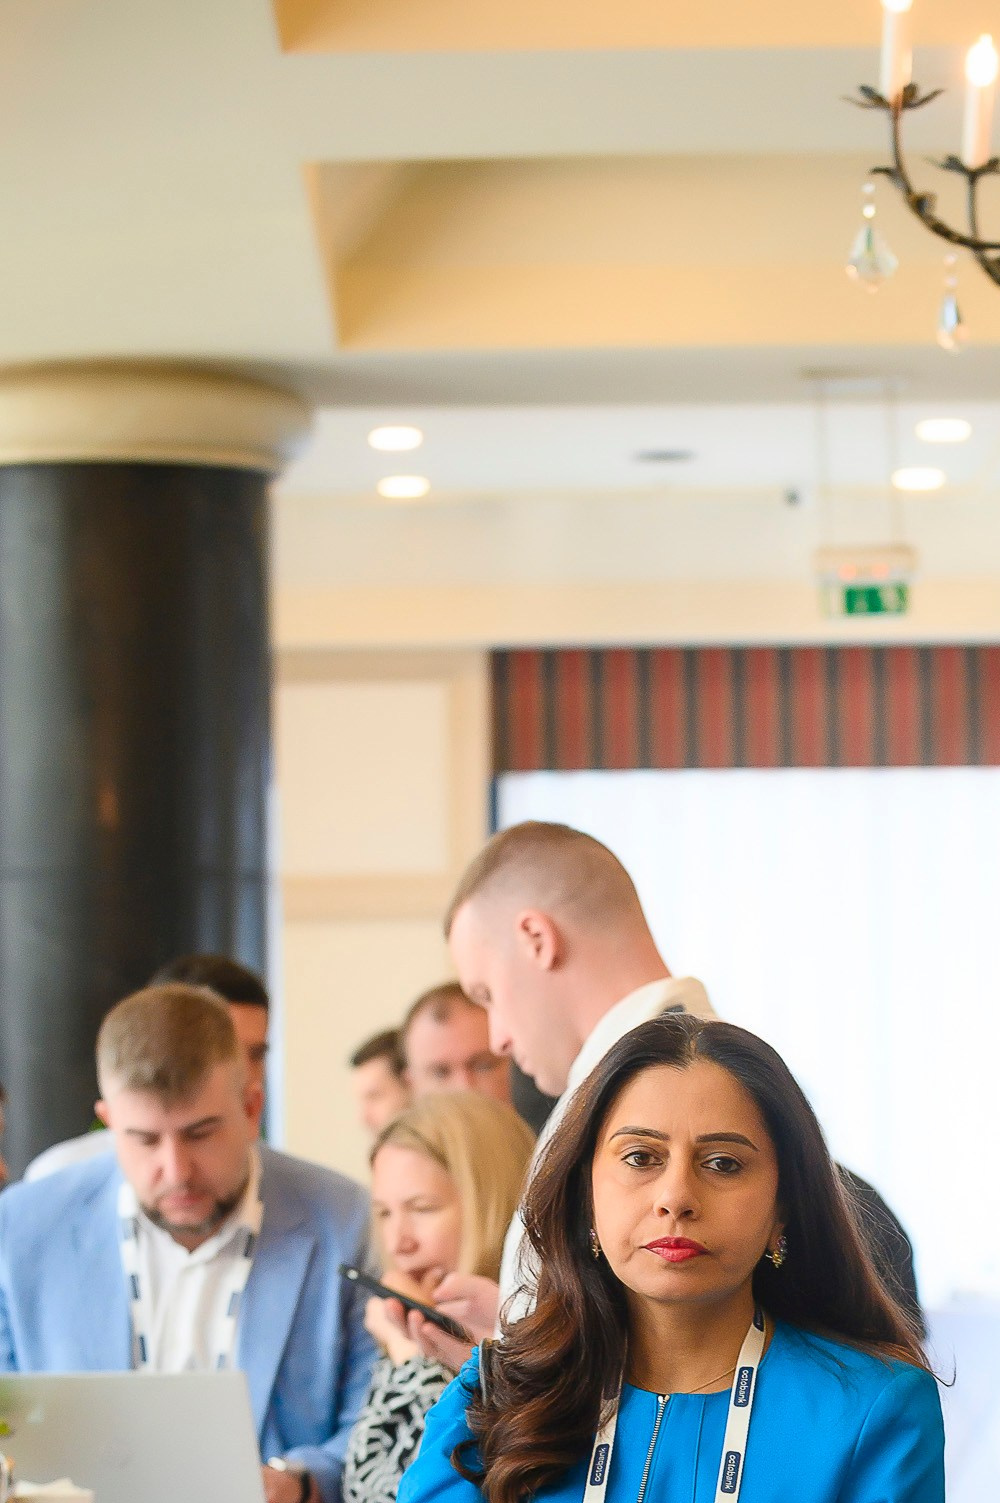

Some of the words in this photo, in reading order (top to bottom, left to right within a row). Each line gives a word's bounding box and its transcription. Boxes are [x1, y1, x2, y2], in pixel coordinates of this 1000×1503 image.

[737, 1369, 749, 1404] octobank
[595, 1447, 606, 1482] octobank
[725, 1454, 736, 1490] octobank
